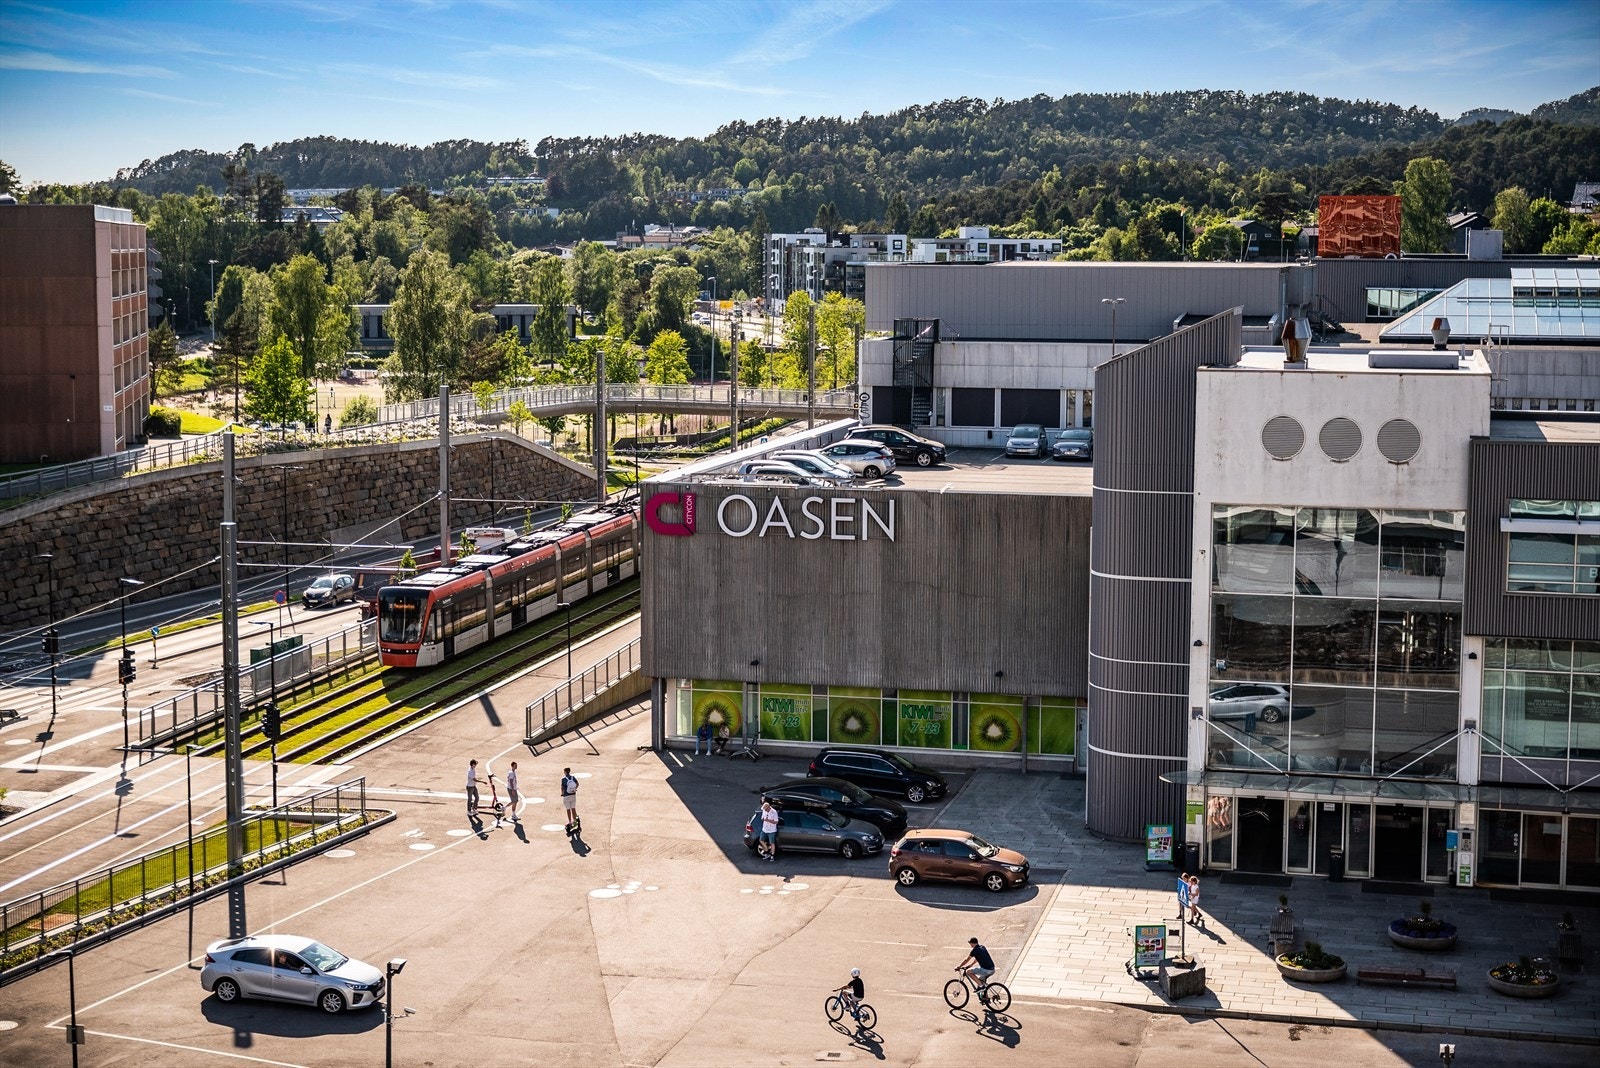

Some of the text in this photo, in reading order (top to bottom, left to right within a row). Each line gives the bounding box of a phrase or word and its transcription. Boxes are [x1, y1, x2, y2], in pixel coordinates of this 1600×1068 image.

[717, 494, 895, 542] OASEN
[762, 697, 795, 713] KIWI
[901, 704, 934, 720] KIWI
